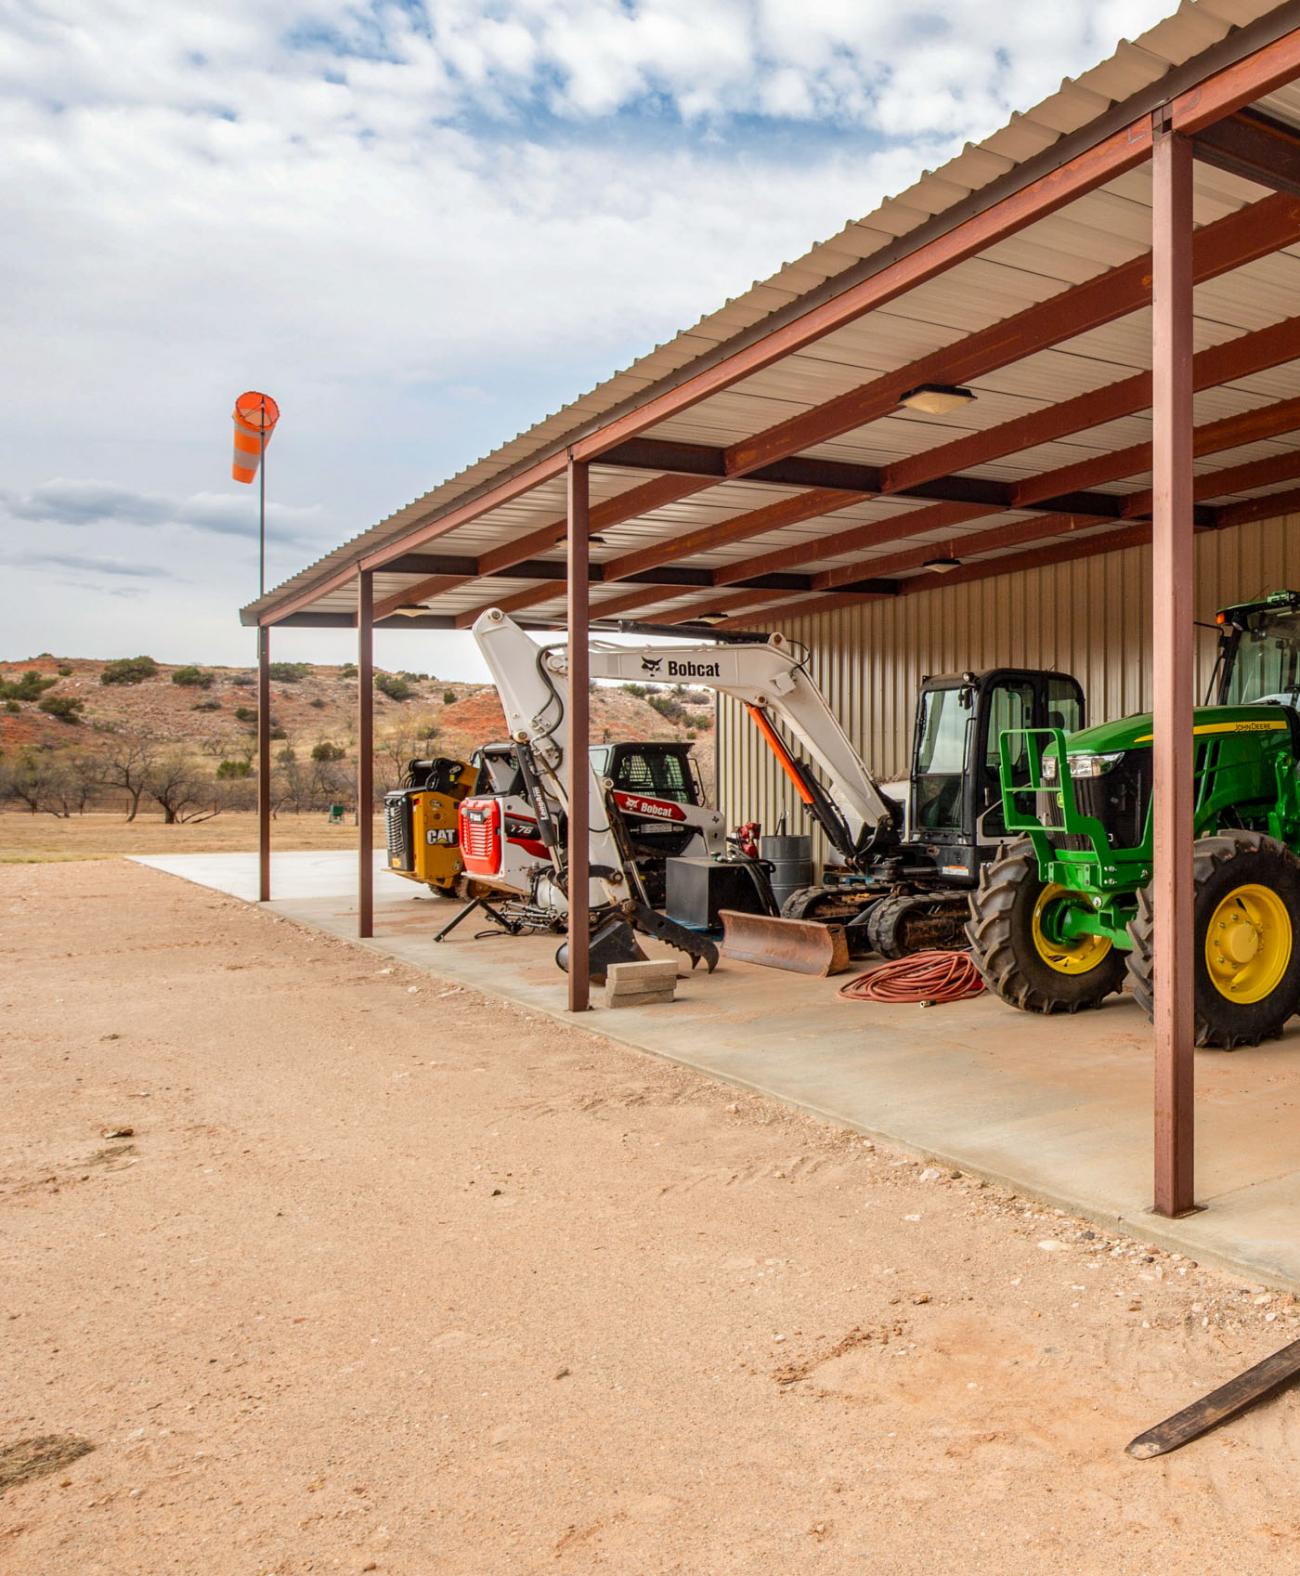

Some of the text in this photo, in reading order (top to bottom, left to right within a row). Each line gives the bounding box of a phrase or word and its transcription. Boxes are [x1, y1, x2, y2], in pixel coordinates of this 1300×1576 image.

[668, 660, 720, 677] Bobcat
[1251, 722, 1271, 730] DEERE
[641, 801, 673, 818] Bobcat
[426, 828, 455, 845] CAT
